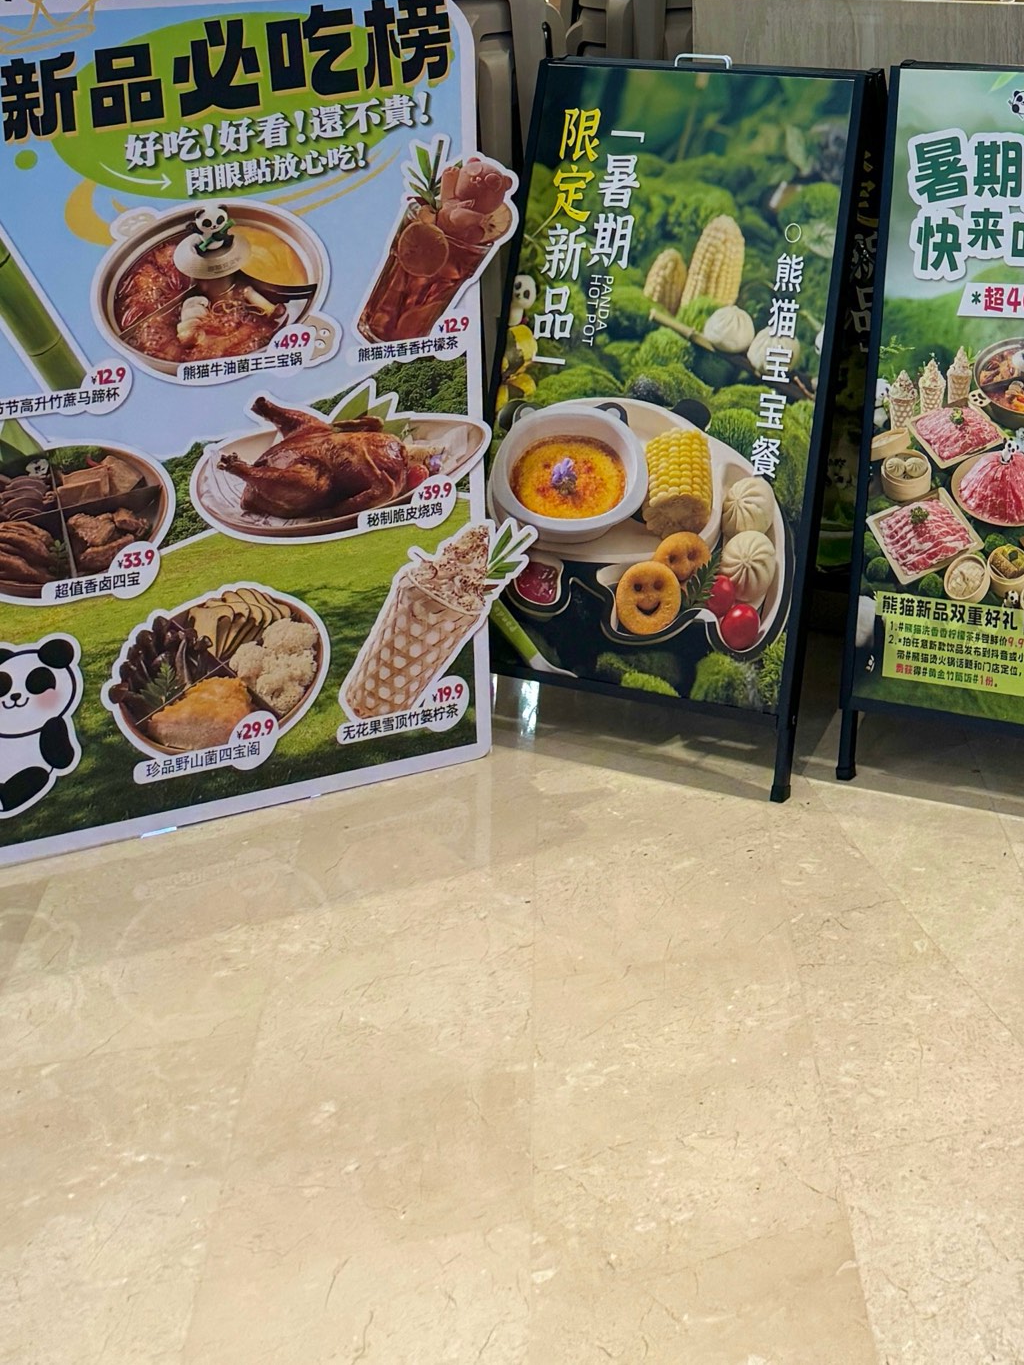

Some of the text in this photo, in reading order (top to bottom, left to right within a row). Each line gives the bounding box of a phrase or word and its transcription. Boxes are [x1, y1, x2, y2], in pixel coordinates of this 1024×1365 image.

[582, 274, 603, 347] HOT POT
[596, 275, 615, 332] PANDA
[439, 316, 469, 334] ¥12.9
[274, 331, 311, 350] ¥49.9
[358, 336, 459, 363] 熊猫洗香香柠檬茶
[91, 366, 126, 386] ¥12.9
[182, 351, 303, 382] 熊猫牛油菌王三宝锅
[750, 252, 805, 480] 熊猫宝宝餐
[417, 481, 453, 502] ¥39.9
[367, 501, 443, 528] 秘制脆皮烧鸡
[117, 549, 155, 570] ¥33.9
[54, 571, 141, 600] 超值香卤四宝
[882, 595, 1018, 631] 熊猫新品双重好礼
[432, 683, 464, 703] ¥19.9
[235, 718, 275, 741] ¥29.9
[145, 741, 261, 779] 珍品野山菌四宝阁
